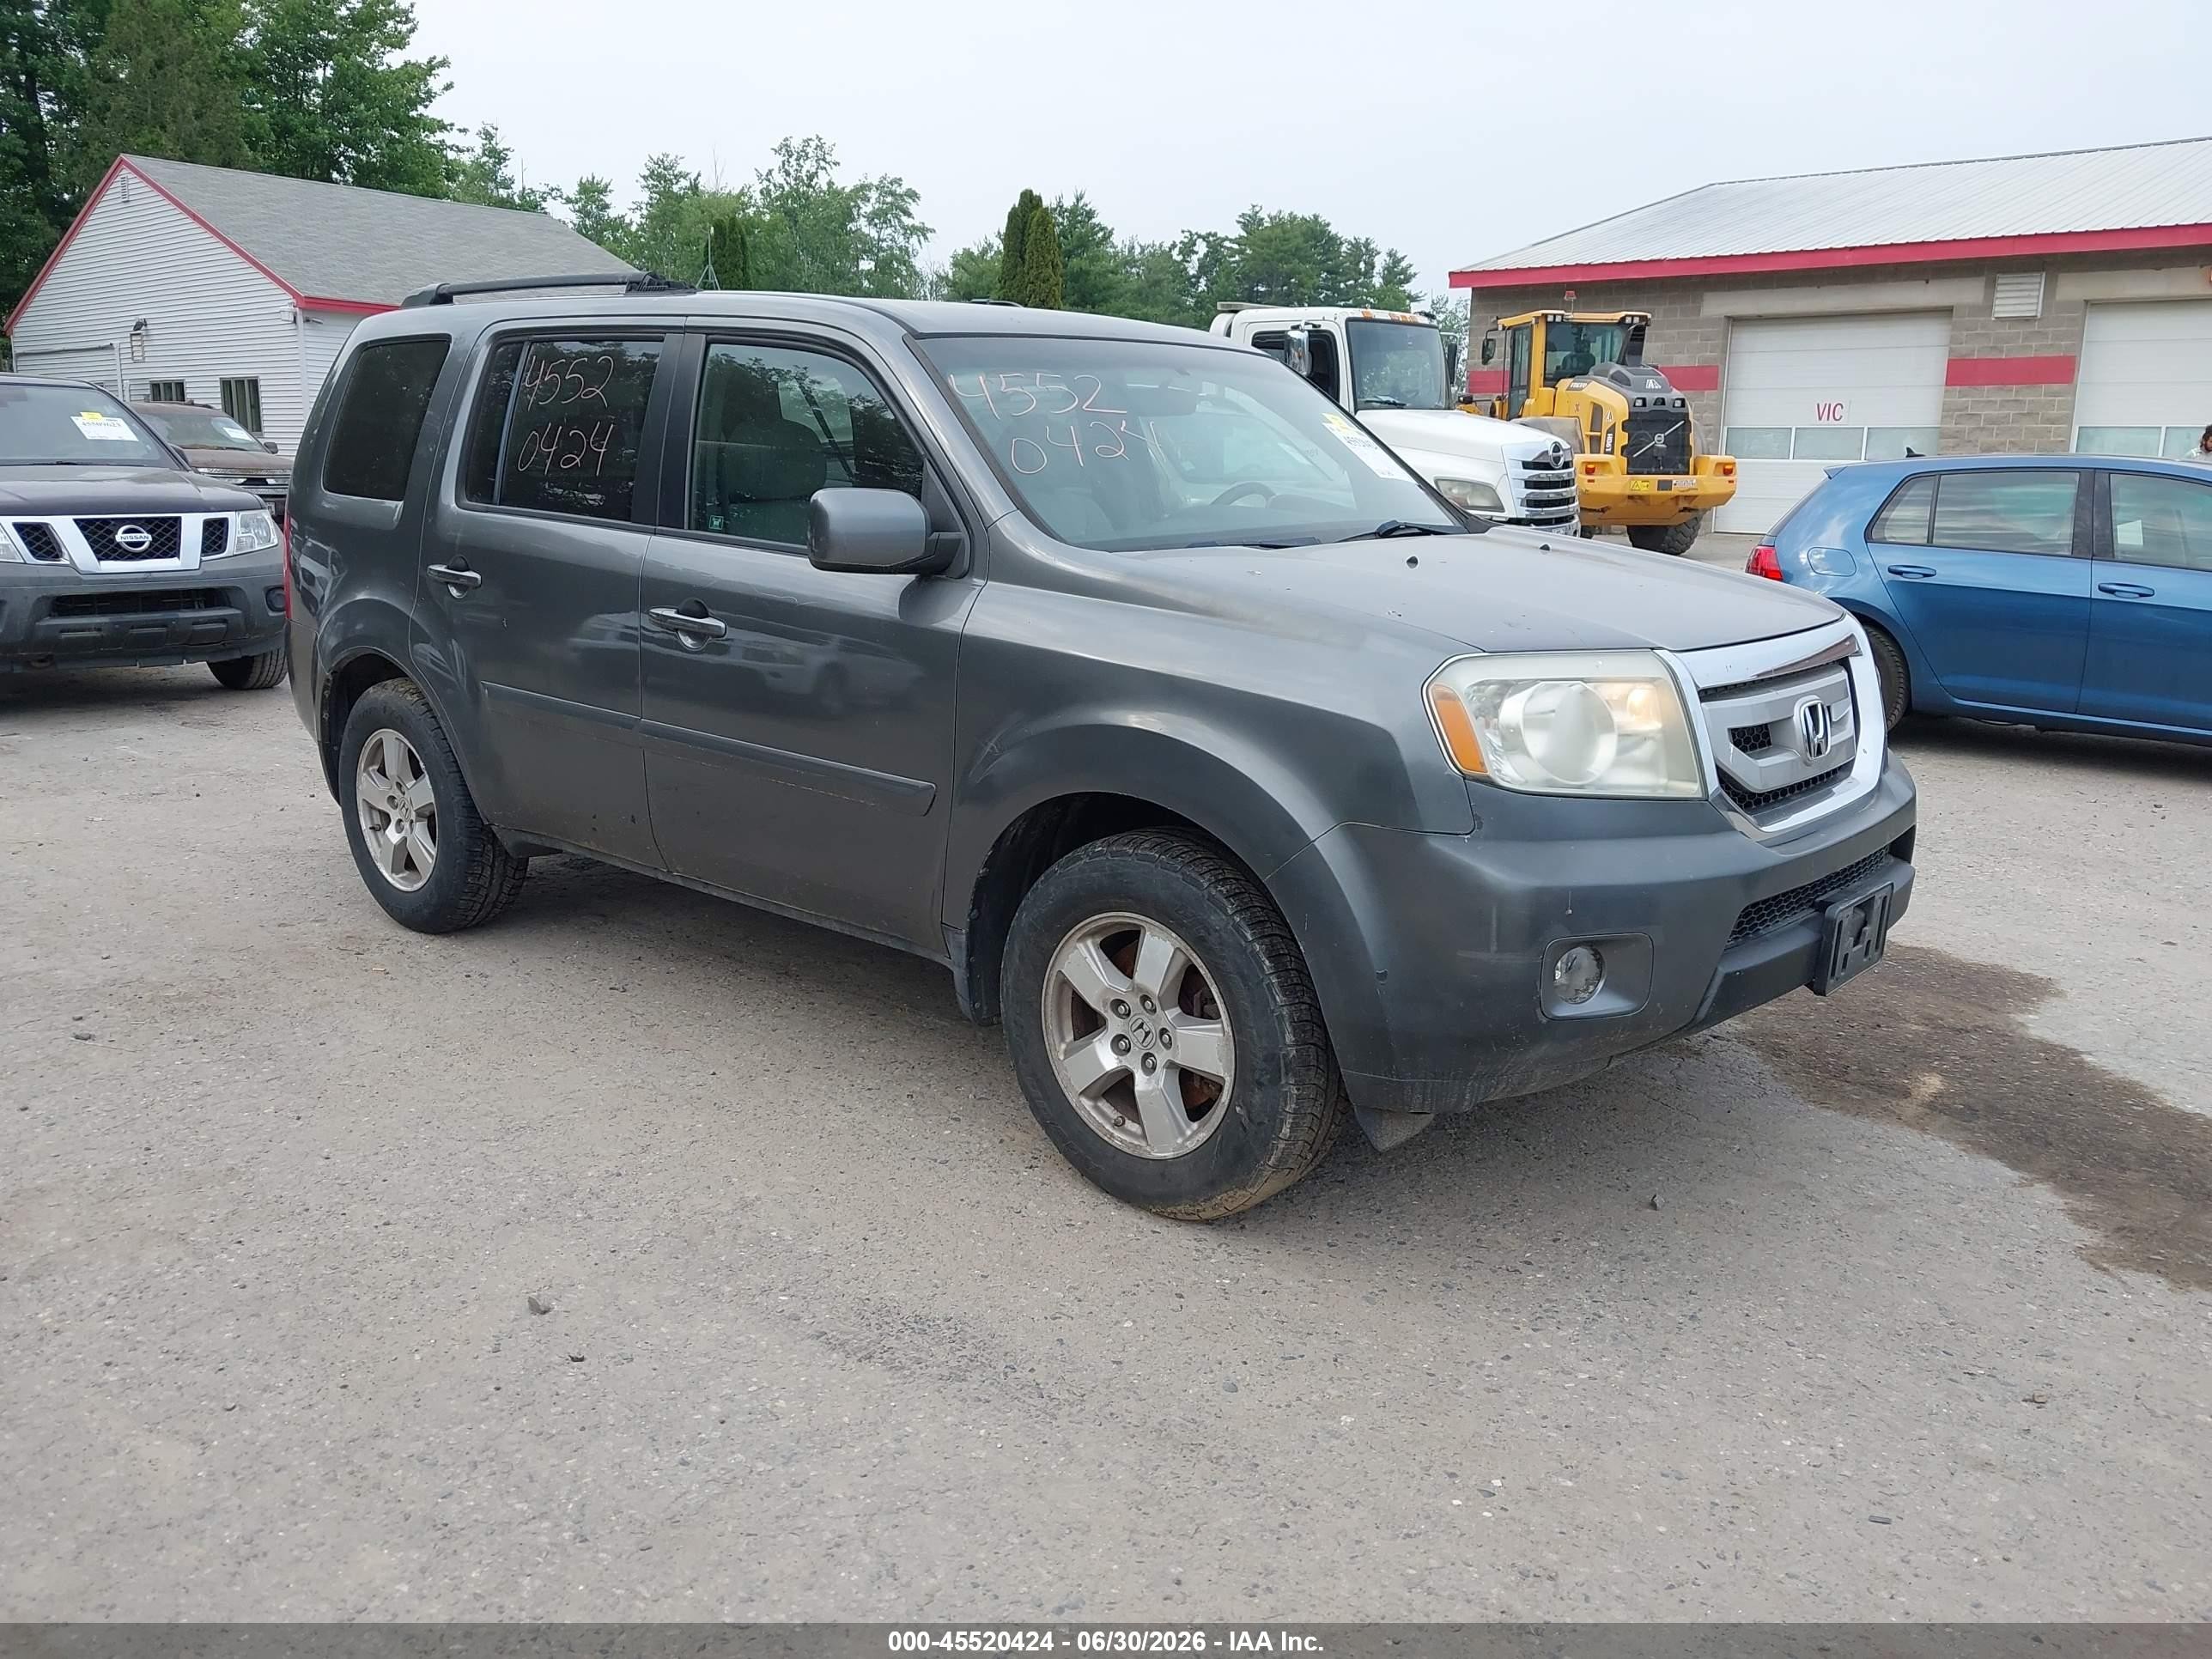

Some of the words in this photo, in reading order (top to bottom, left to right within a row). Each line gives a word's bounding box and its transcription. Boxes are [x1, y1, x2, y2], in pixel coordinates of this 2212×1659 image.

[525, 356, 614, 411] 4552
[948, 373, 1127, 420] 4552
[1816, 402, 1844, 422] VIC
[518, 422, 614, 477] 0424
[1011, 419, 1167, 474] 0424
